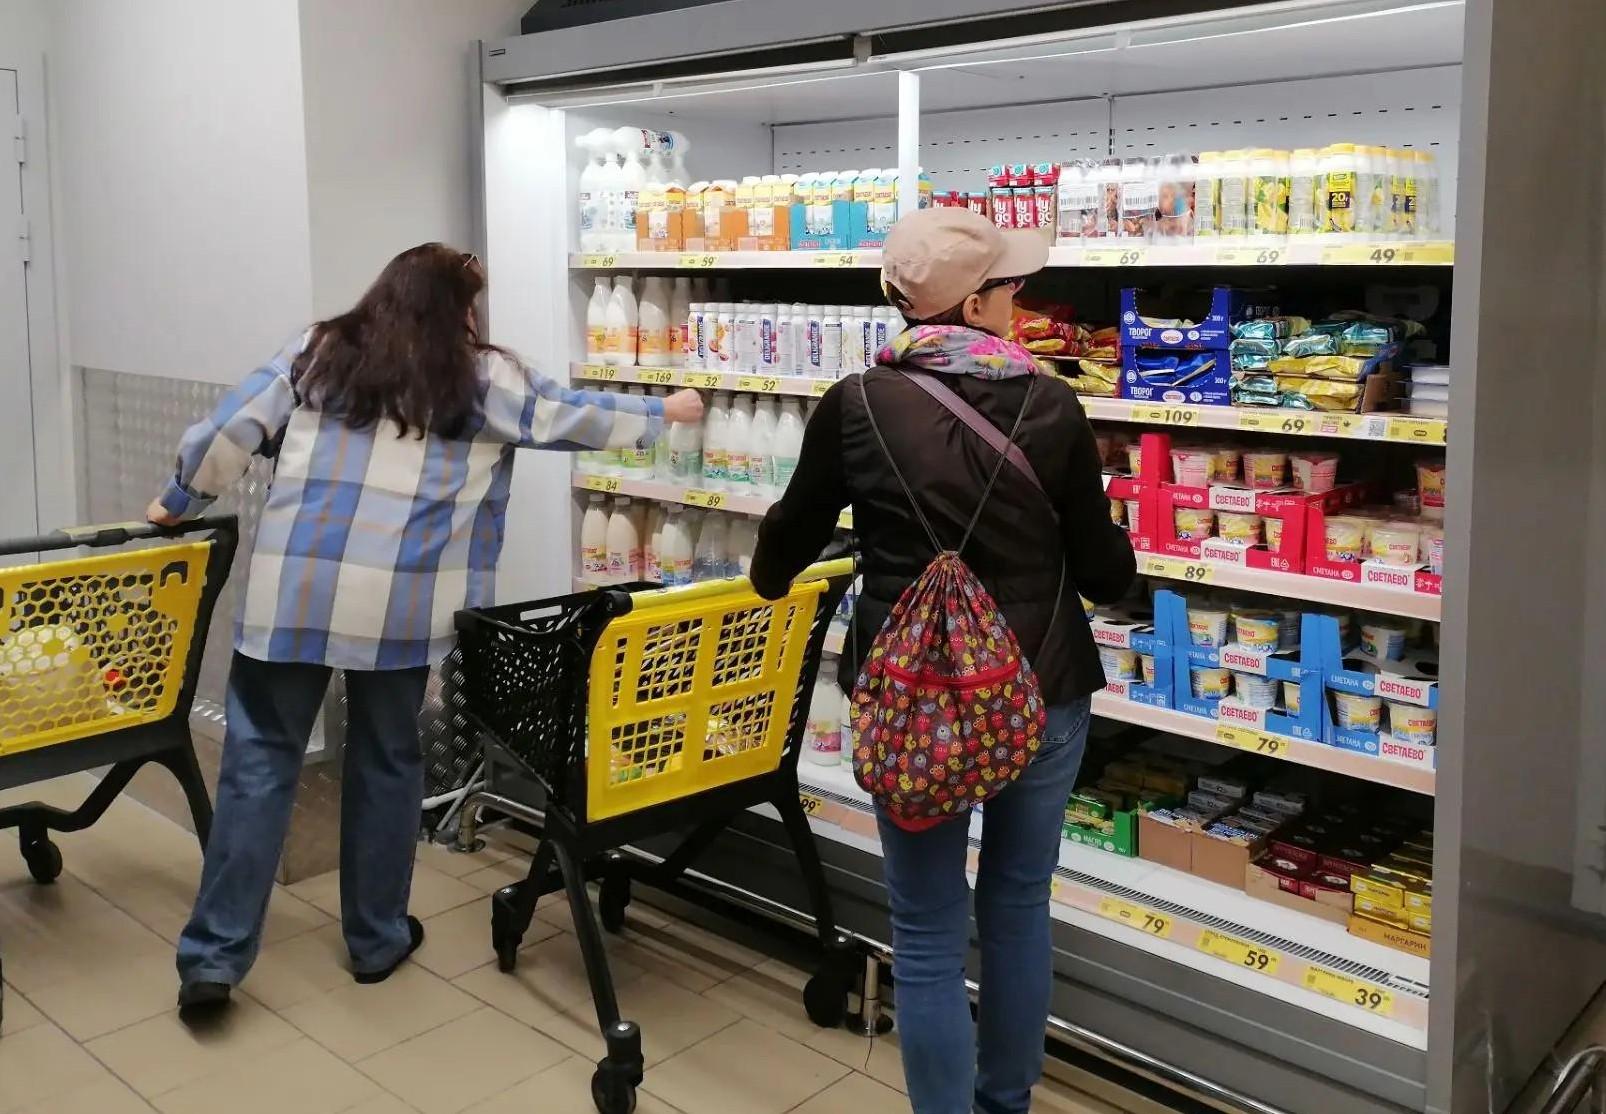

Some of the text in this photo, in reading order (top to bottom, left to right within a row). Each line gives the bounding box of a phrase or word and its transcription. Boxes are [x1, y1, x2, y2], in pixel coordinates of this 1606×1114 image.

[602, 257, 614, 267] 69
[701, 257, 715, 267] 59
[839, 256, 853, 266] 54
[1119, 251, 1140, 265] 69
[1257, 251, 1279, 265] 69
[1370, 249, 1395, 264] 49
[1128, 327, 1152, 337] ТВОРОГ
[599, 369, 615, 380] 119
[655, 373, 672, 383] 169
[704, 377, 718, 387] 52
[761, 380, 776, 391] 52
[1130, 387, 1154, 396] ТВОРОГ
[1164, 409, 1193, 423] 109
[1281, 418, 1305, 431] 69
[605, 481, 618, 491] 84
[706, 496, 721, 506] 89
[1215, 494, 1250, 507] СВЕТАЕВО
[1204, 548, 1239, 563] СВЕТАЕВО
[1184, 566, 1206, 580] 89
[1368, 570, 1408, 586] СВЕТАЕВО
[1093, 629, 1125, 644] СВЕТАЕВО
[1224, 652, 1260, 668] СВЕТАЕВО
[1380, 681, 1422, 699] СВЕТАЕВО
[1220, 705, 1258, 722] СВЕТАЕВО
[1256, 738, 1279, 754] 79
[1382, 742, 1424, 761] СВЕТАЕВО
[1143, 915, 1165, 933] 79
[1384, 932, 1427, 951] МАРГАРИН
[1244, 950, 1269, 970] 59
[1354, 988, 1382, 1009] 39
